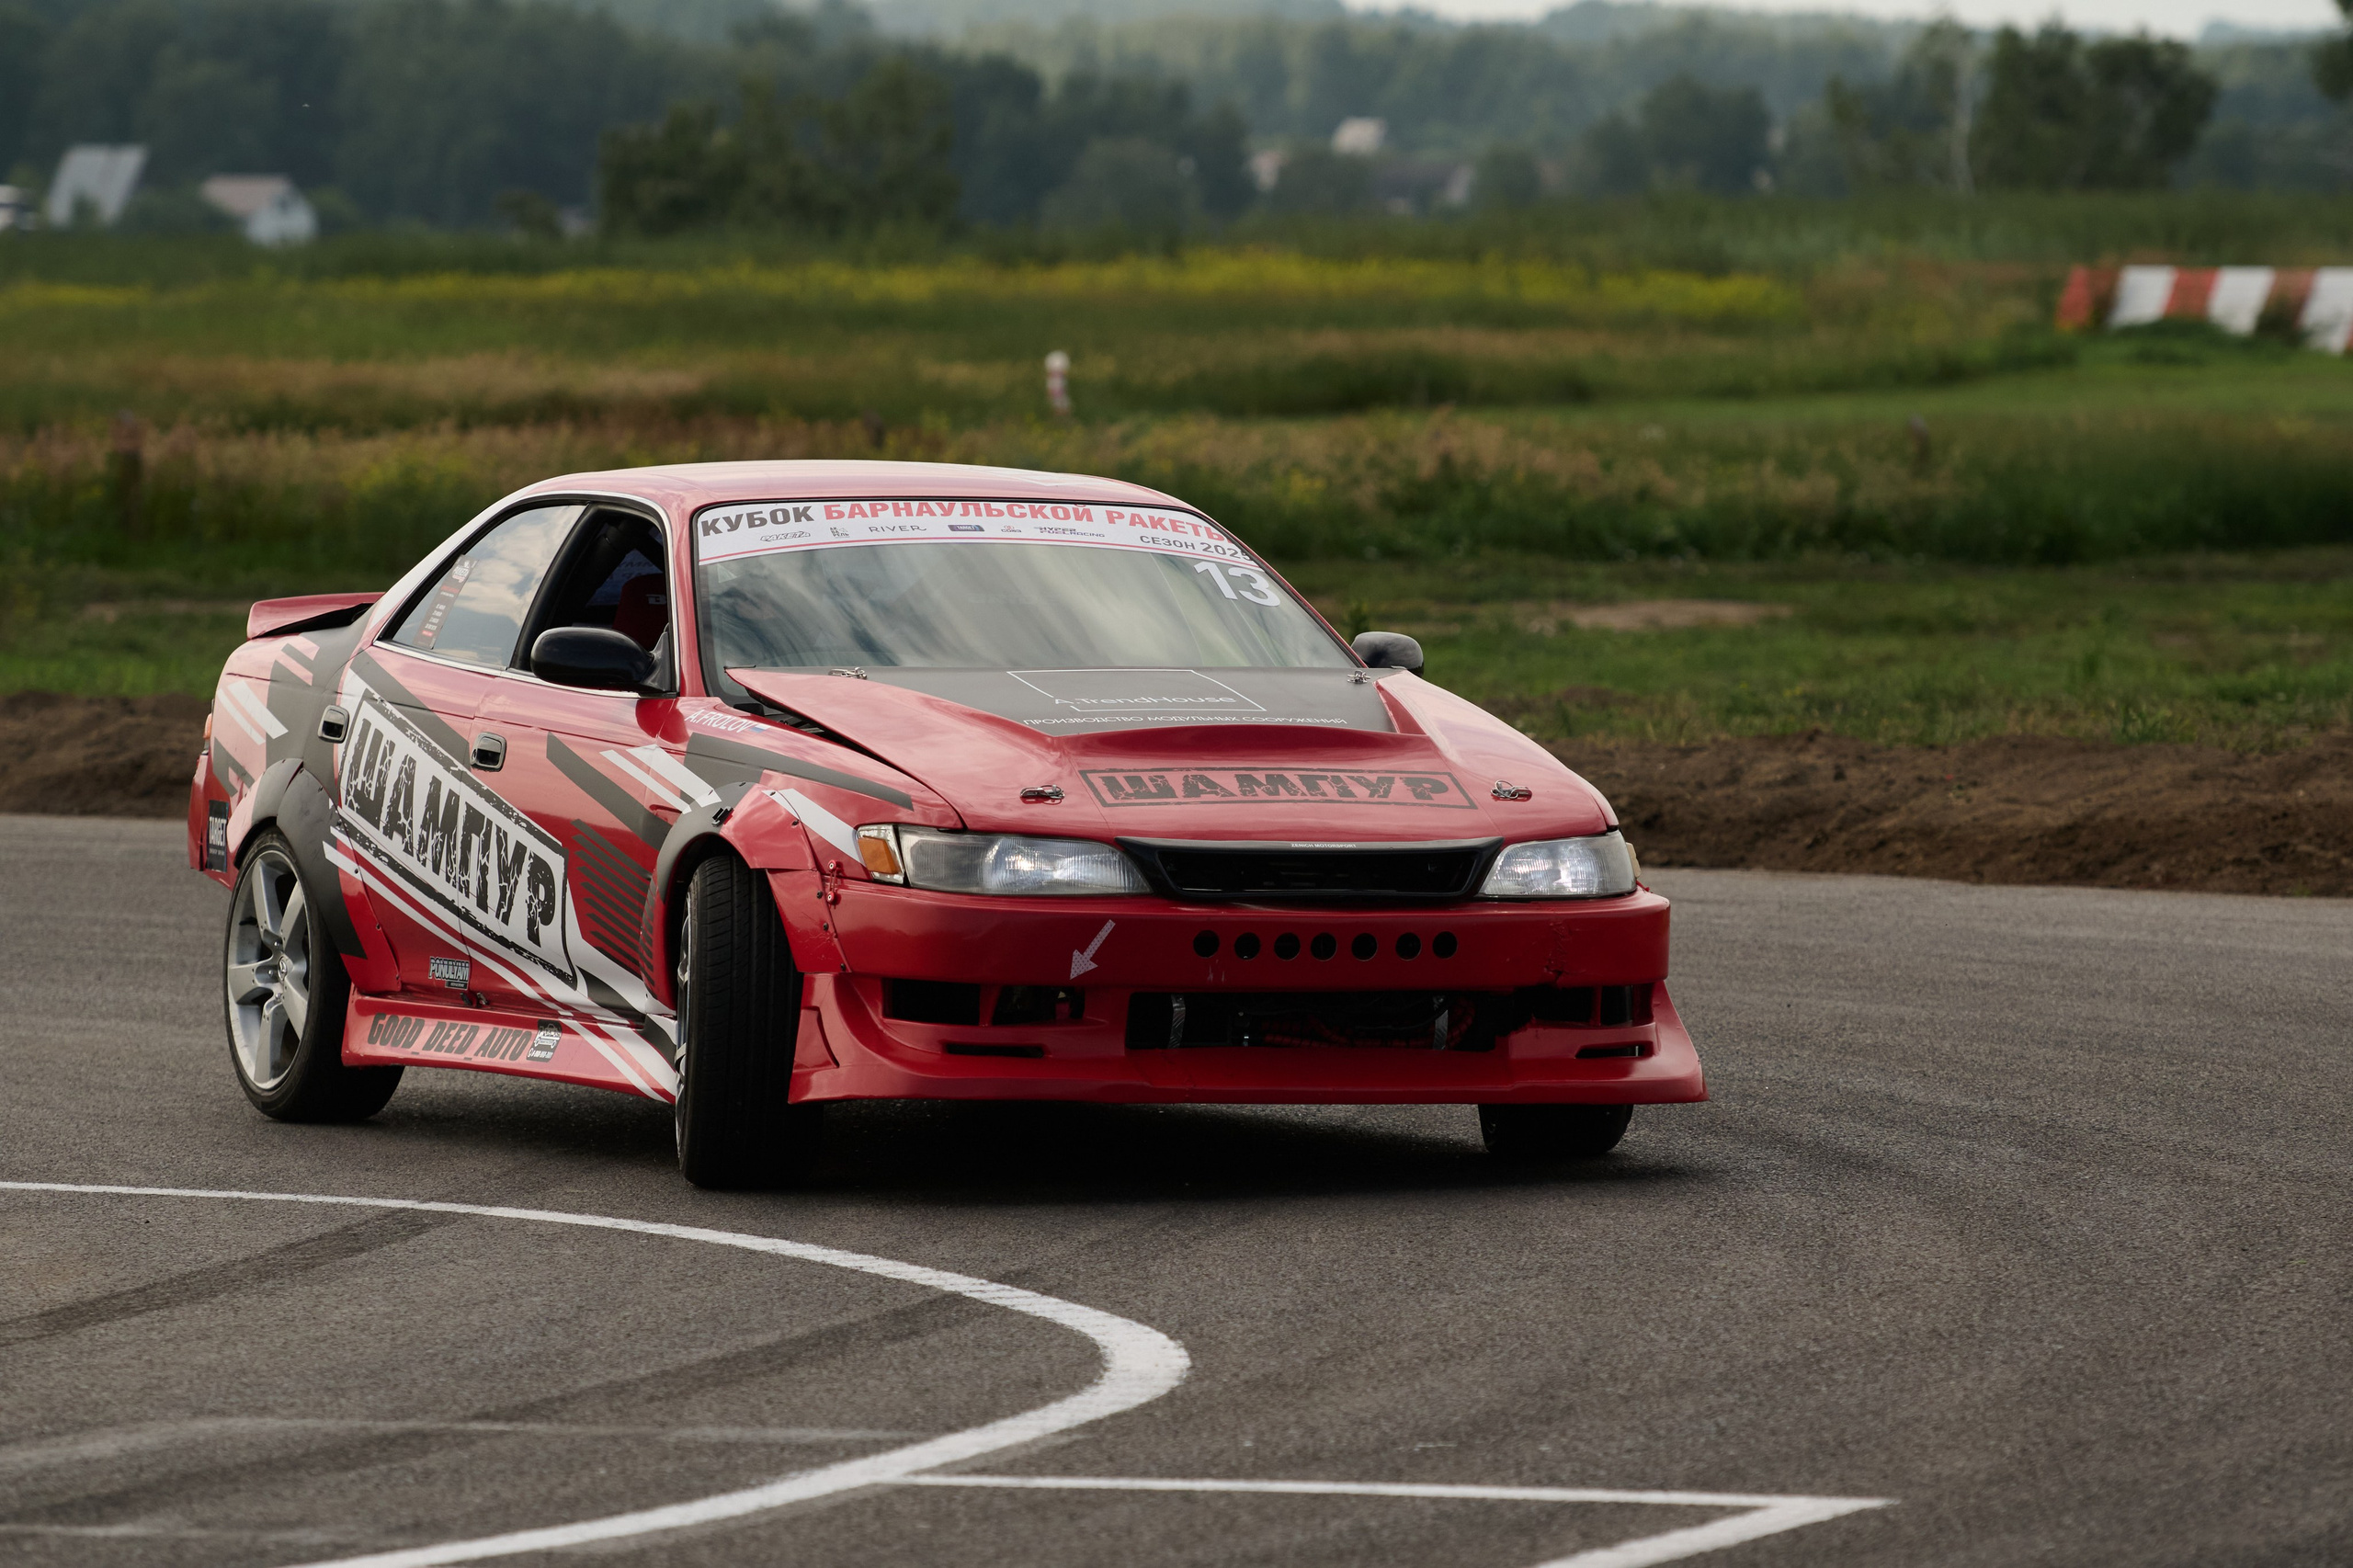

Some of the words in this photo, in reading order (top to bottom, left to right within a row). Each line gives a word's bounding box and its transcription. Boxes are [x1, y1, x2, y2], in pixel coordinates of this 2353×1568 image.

[701, 506, 815, 537] КУБОК
[824, 502, 1094, 522] БАРНАУЛЬСКОЙ
[869, 525, 926, 533] RIVER
[1140, 535, 1196, 551] СЕЗОН
[1194, 562, 1280, 607] 13
[684, 710, 757, 733] A.FROLOV
[1101, 774, 1450, 801] ШАМПУР
[345, 718, 555, 948] ШАМПУР
